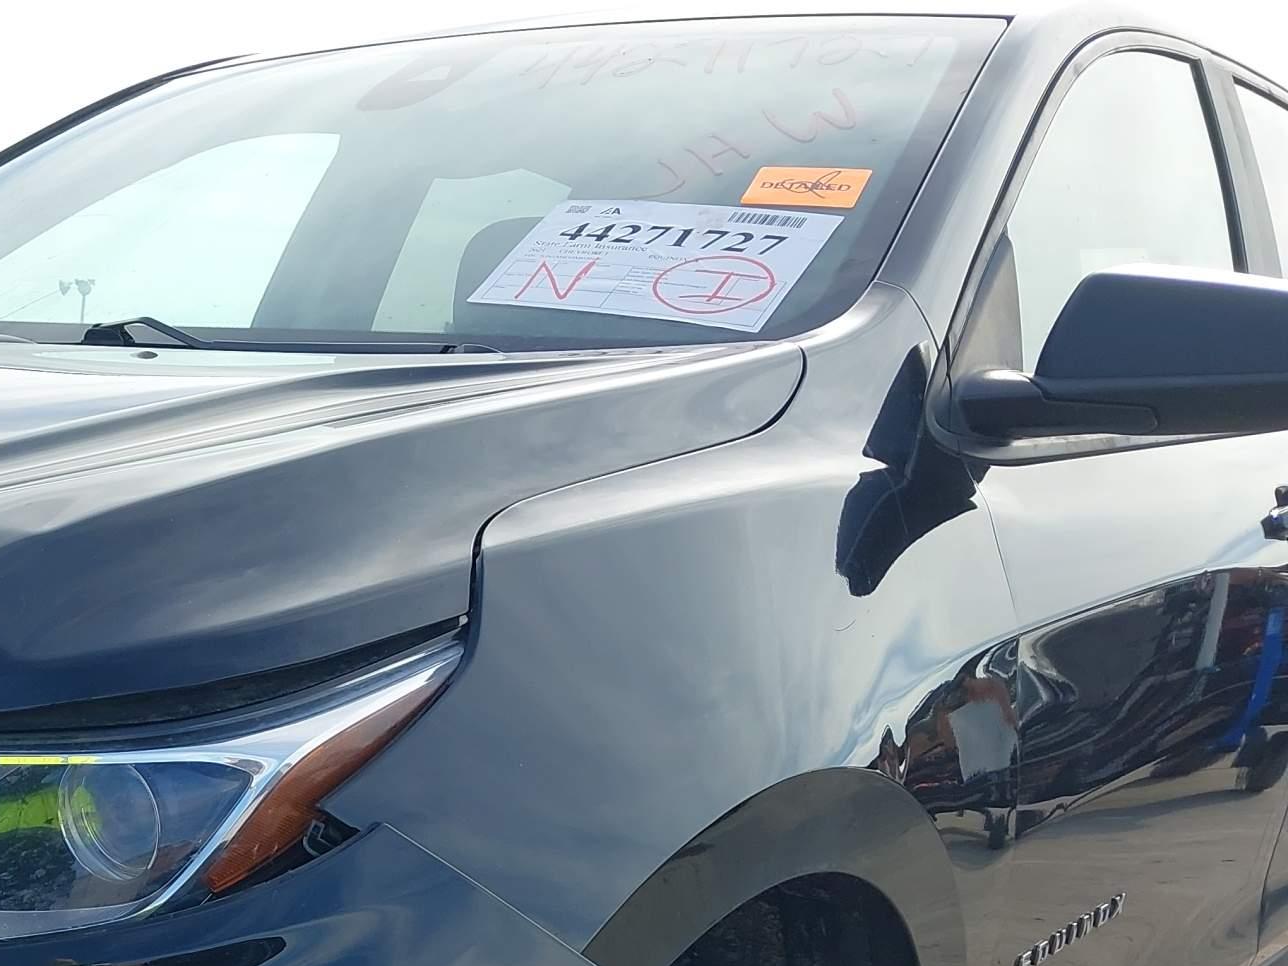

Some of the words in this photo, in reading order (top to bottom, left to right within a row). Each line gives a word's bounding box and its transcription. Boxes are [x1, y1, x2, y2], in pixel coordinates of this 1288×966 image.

[559, 222, 790, 256] 44271727
[594, 243, 648, 252] Insurance
[513, 257, 600, 301] N
